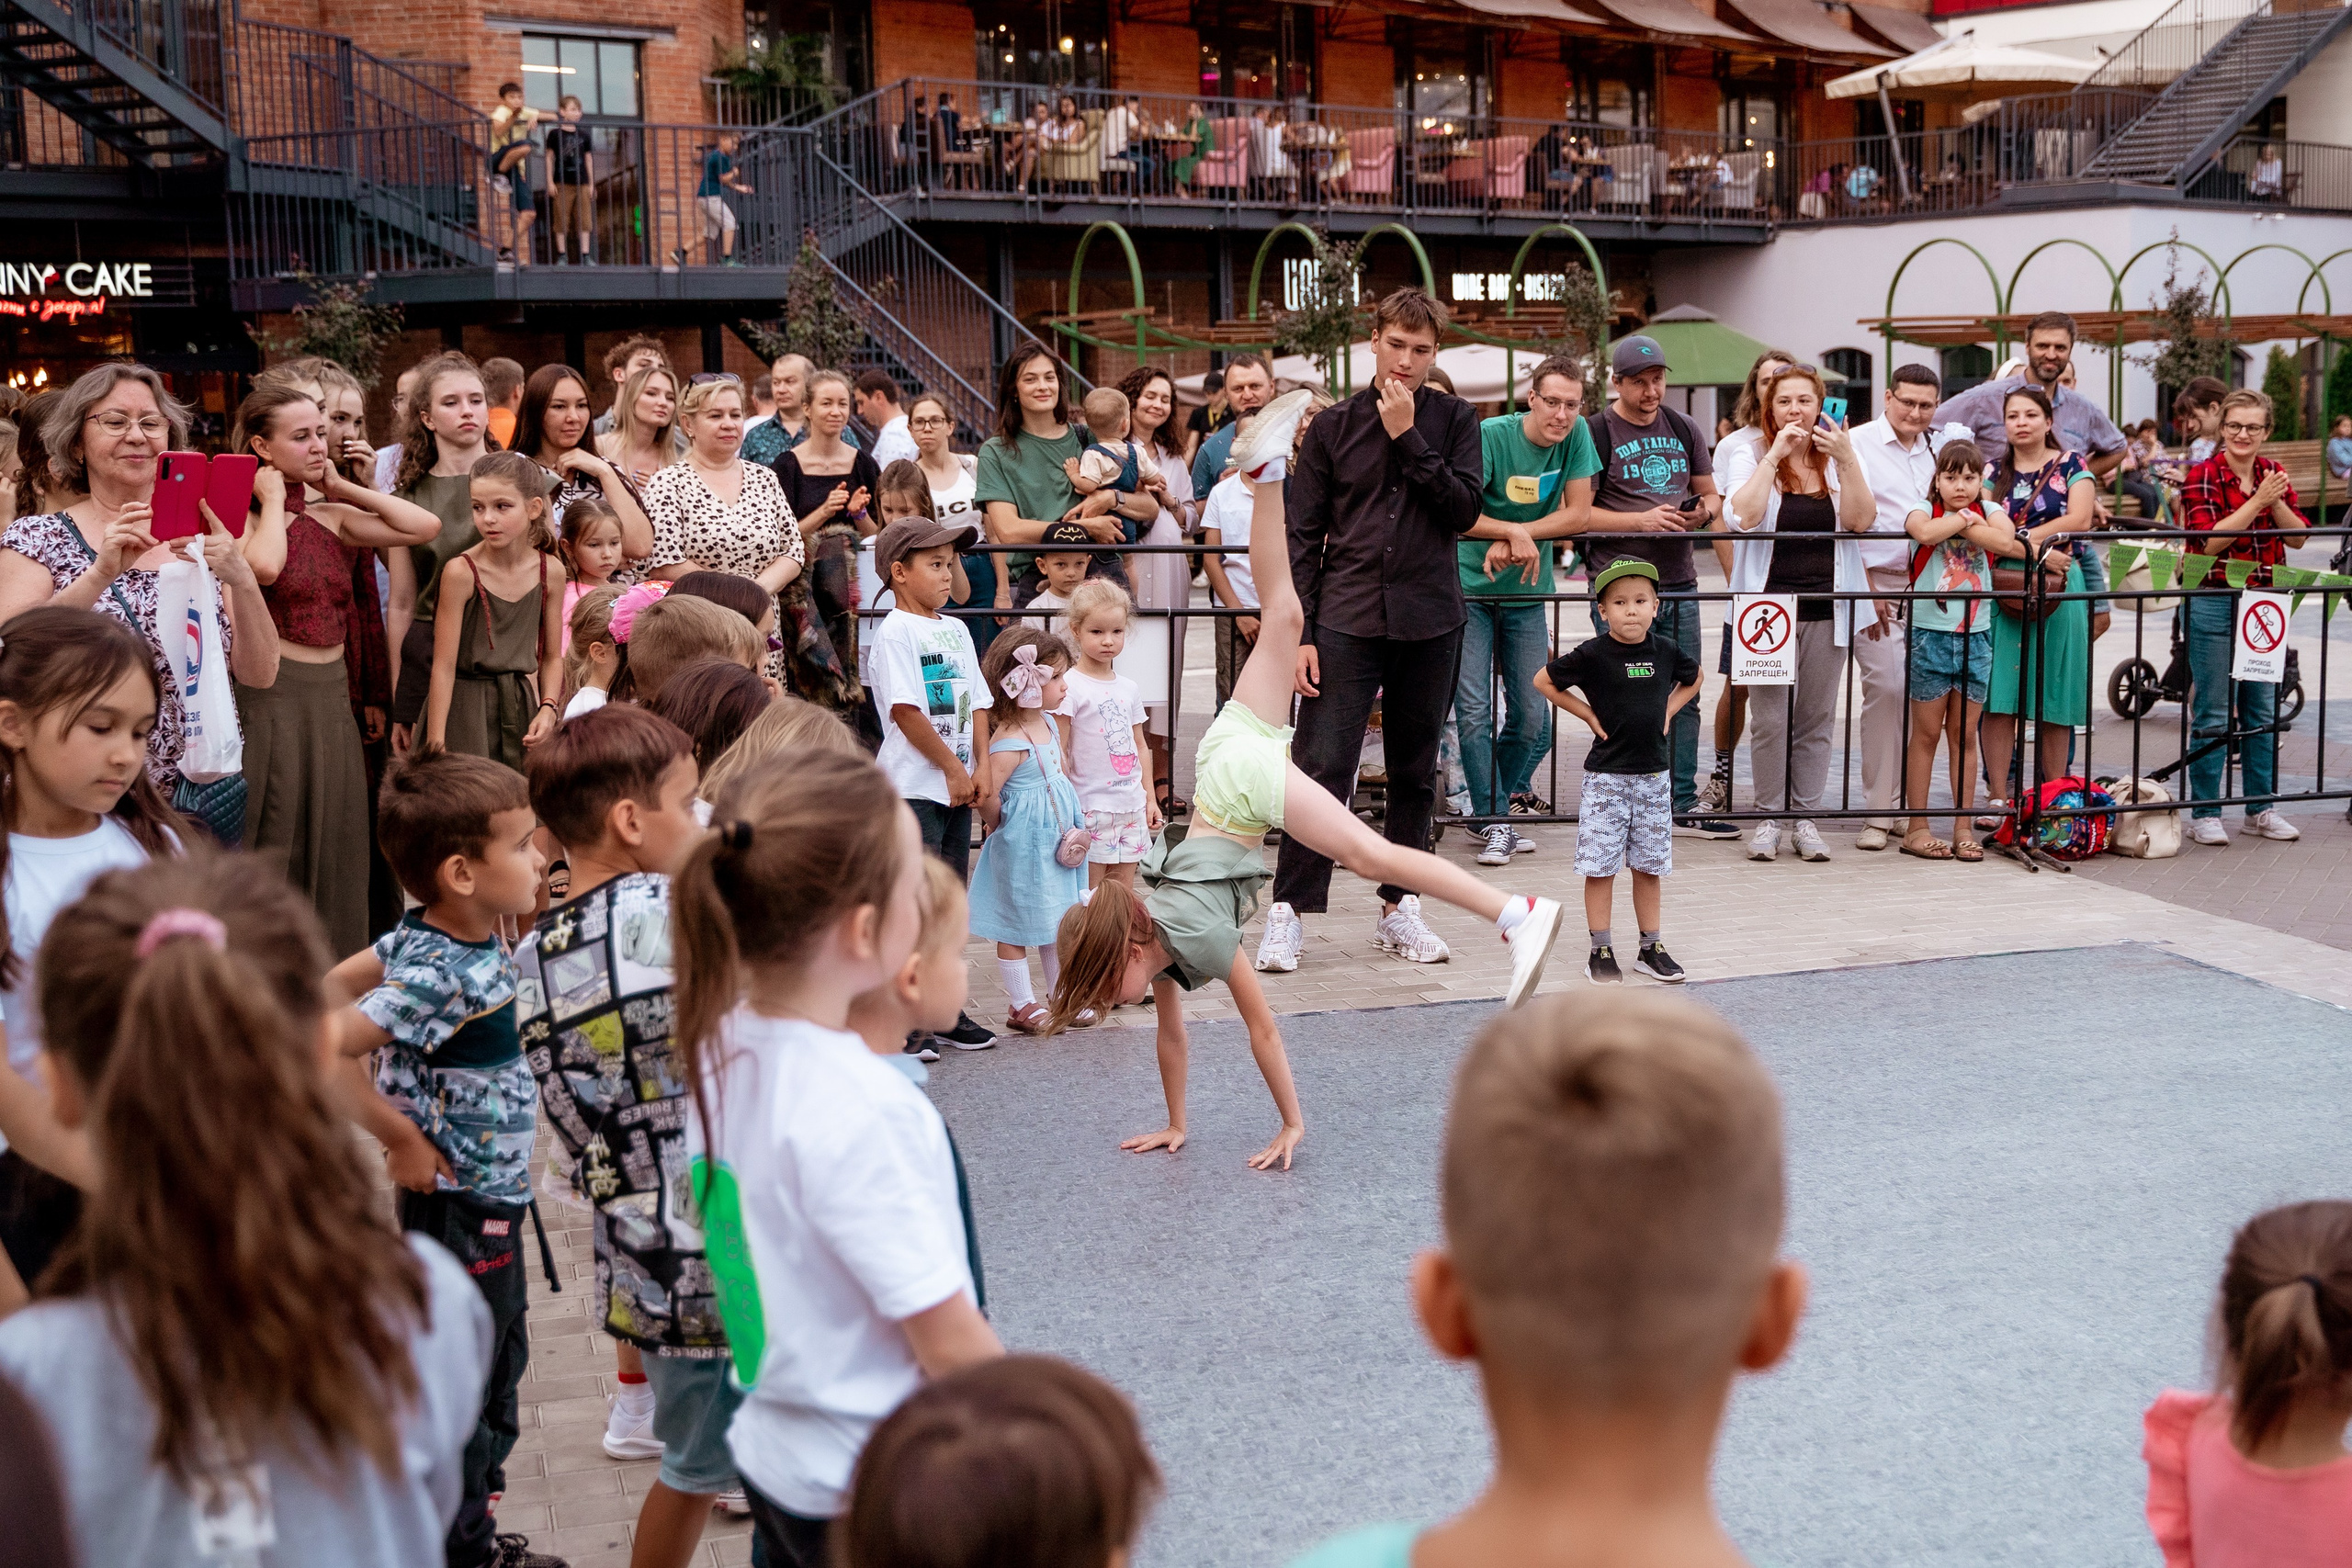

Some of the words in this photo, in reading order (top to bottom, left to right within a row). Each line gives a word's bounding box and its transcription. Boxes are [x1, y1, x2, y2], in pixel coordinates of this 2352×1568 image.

[0, 261, 56, 296] NY
[65, 261, 153, 297] CAKE
[1615, 439, 1642, 459] TOM
[2152, 562, 2171, 571] DANCE
[921, 653, 944, 667] DINO
[2248, 659, 2271, 668] ПРОХОД
[1738, 670, 1788, 678] ЗАПРЕЩЕН
[2243, 666, 2275, 675] ЗАПРЕЩЕН
[617, 1100, 673, 1124] RULES
[482, 1219, 511, 1236] MARVEL
